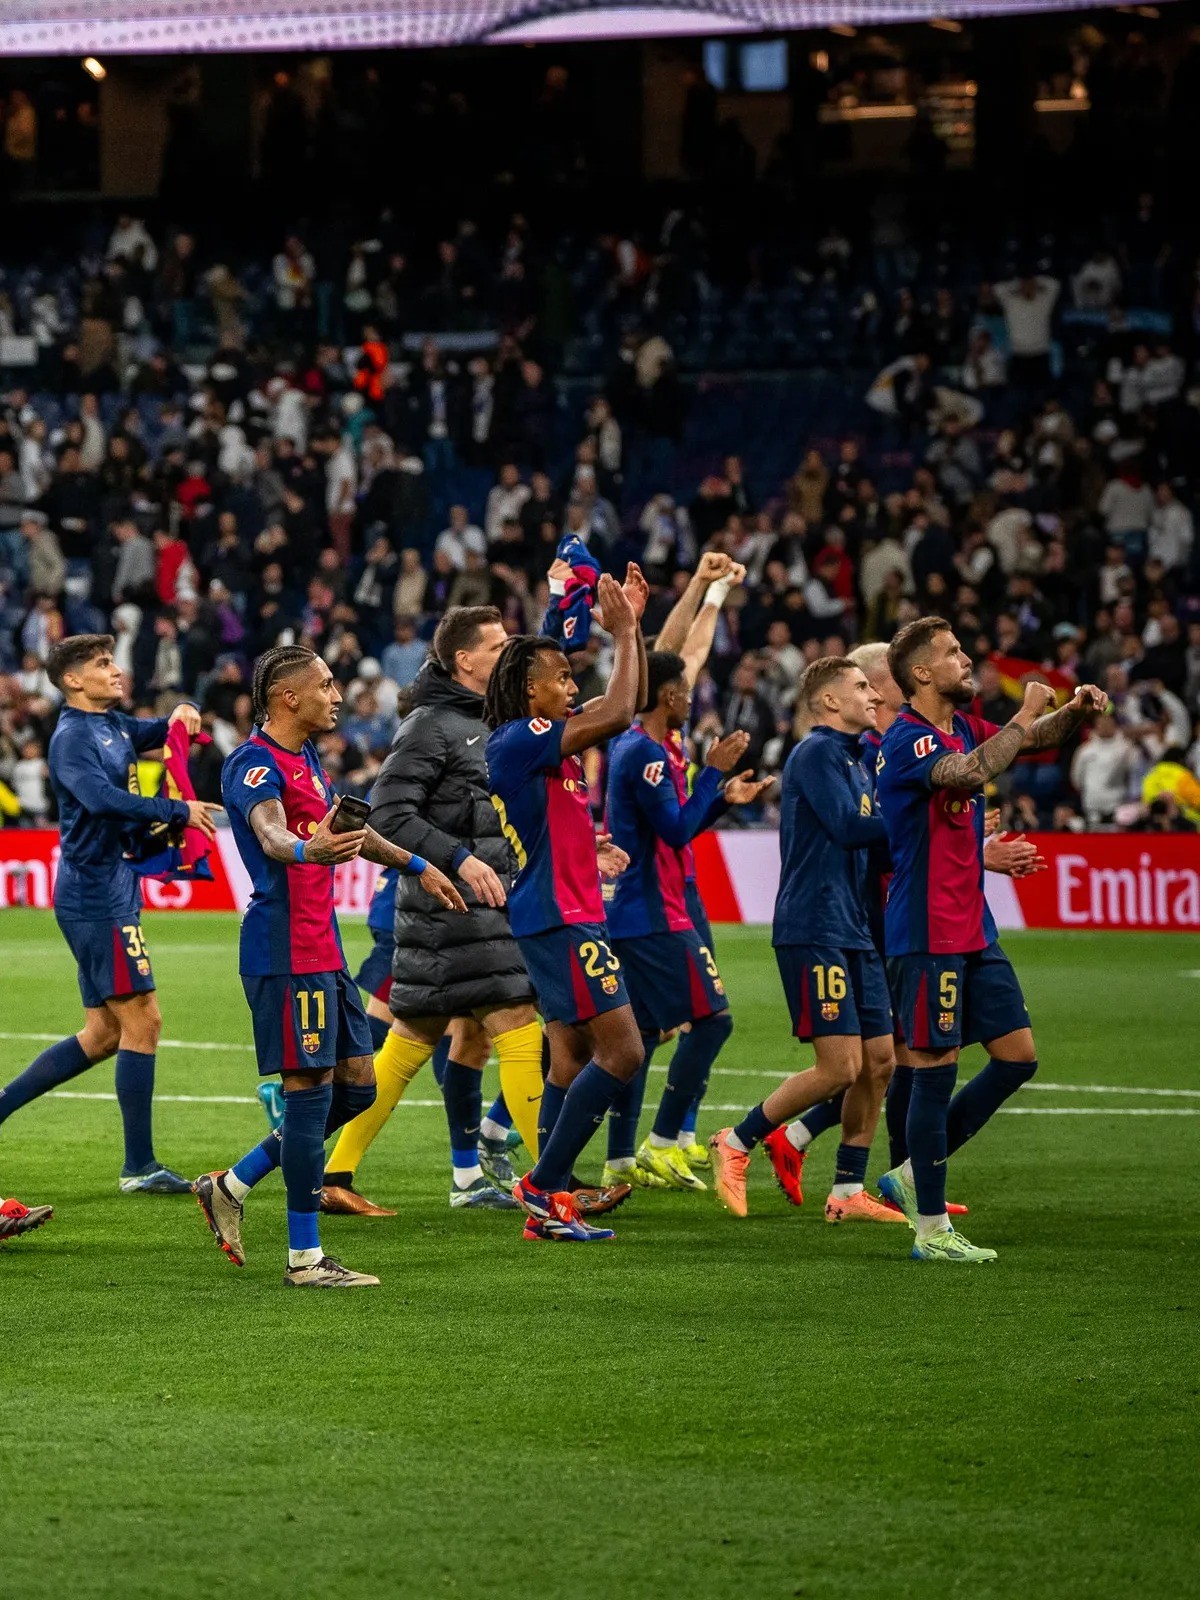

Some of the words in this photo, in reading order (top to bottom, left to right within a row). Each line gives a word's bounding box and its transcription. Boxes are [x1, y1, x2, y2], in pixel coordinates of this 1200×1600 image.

[579, 940, 620, 977] 23
[812, 965, 847, 1000] 16
[939, 971, 958, 1009] 5
[296, 990, 326, 1030] 11
